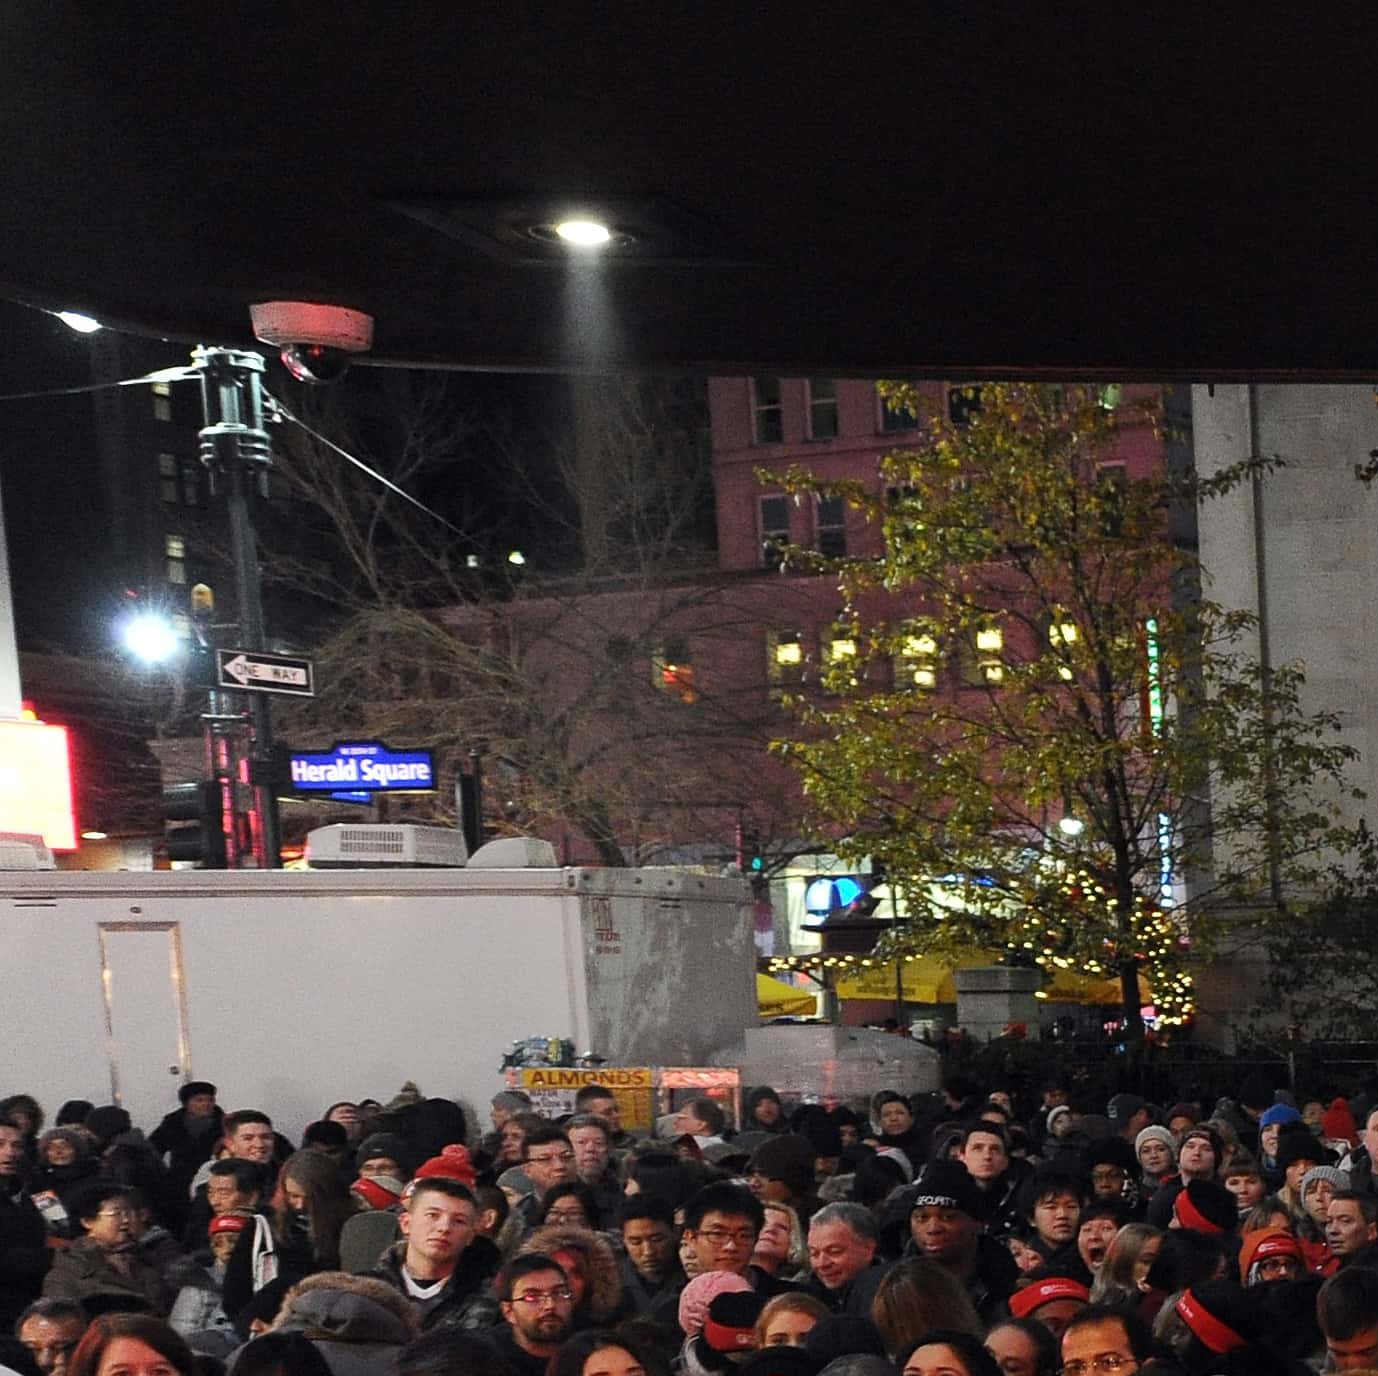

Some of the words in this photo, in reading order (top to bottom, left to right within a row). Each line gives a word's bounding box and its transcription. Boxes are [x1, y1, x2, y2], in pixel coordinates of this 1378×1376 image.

[234, 662, 260, 678] ONE
[273, 669, 299, 682] WAY
[290, 758, 357, 783] Herald
[360, 759, 431, 786] Square
[531, 1070, 645, 1086] ALMONDS
[916, 1194, 958, 1206] SECURITY
